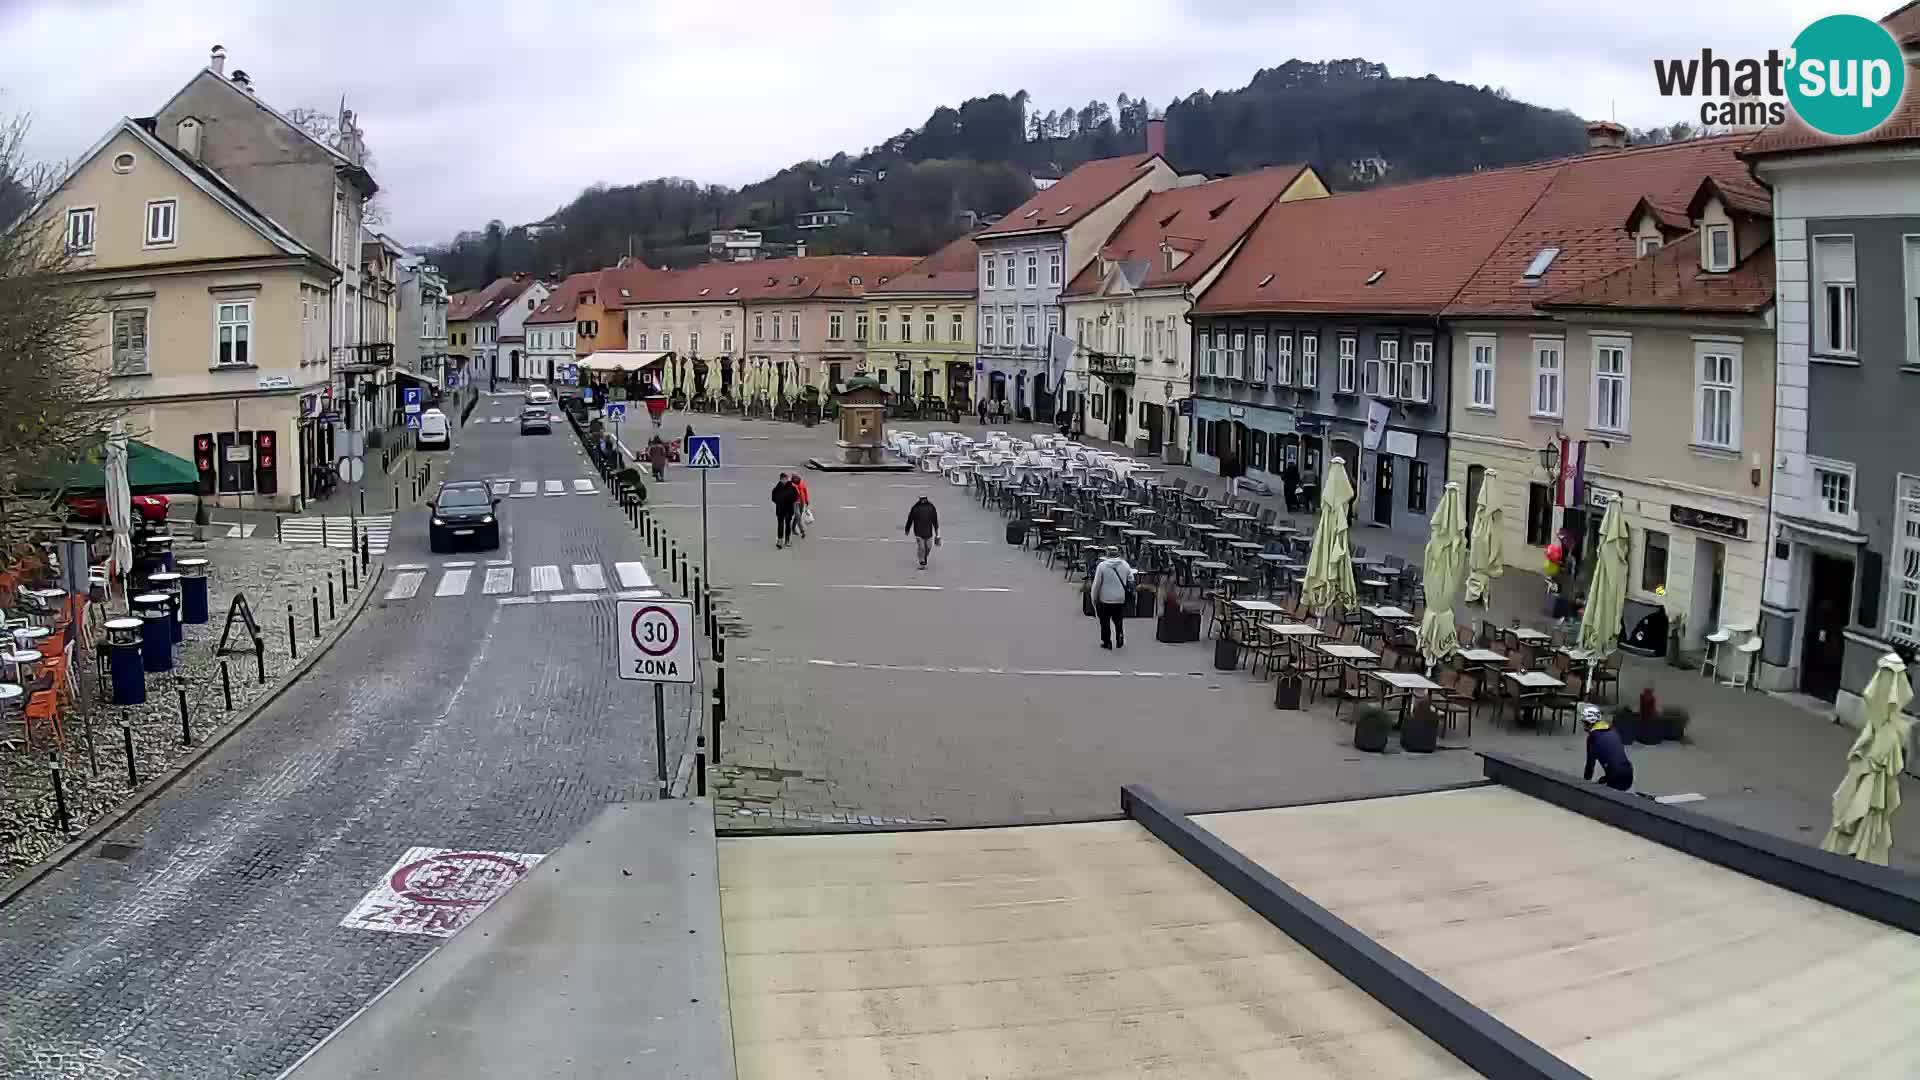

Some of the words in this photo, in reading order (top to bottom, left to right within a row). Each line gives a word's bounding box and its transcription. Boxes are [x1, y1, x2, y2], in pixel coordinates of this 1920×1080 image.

[409, 392, 416, 402] P
[644, 622, 667, 643] 30
[634, 659, 678, 676] ZONA
